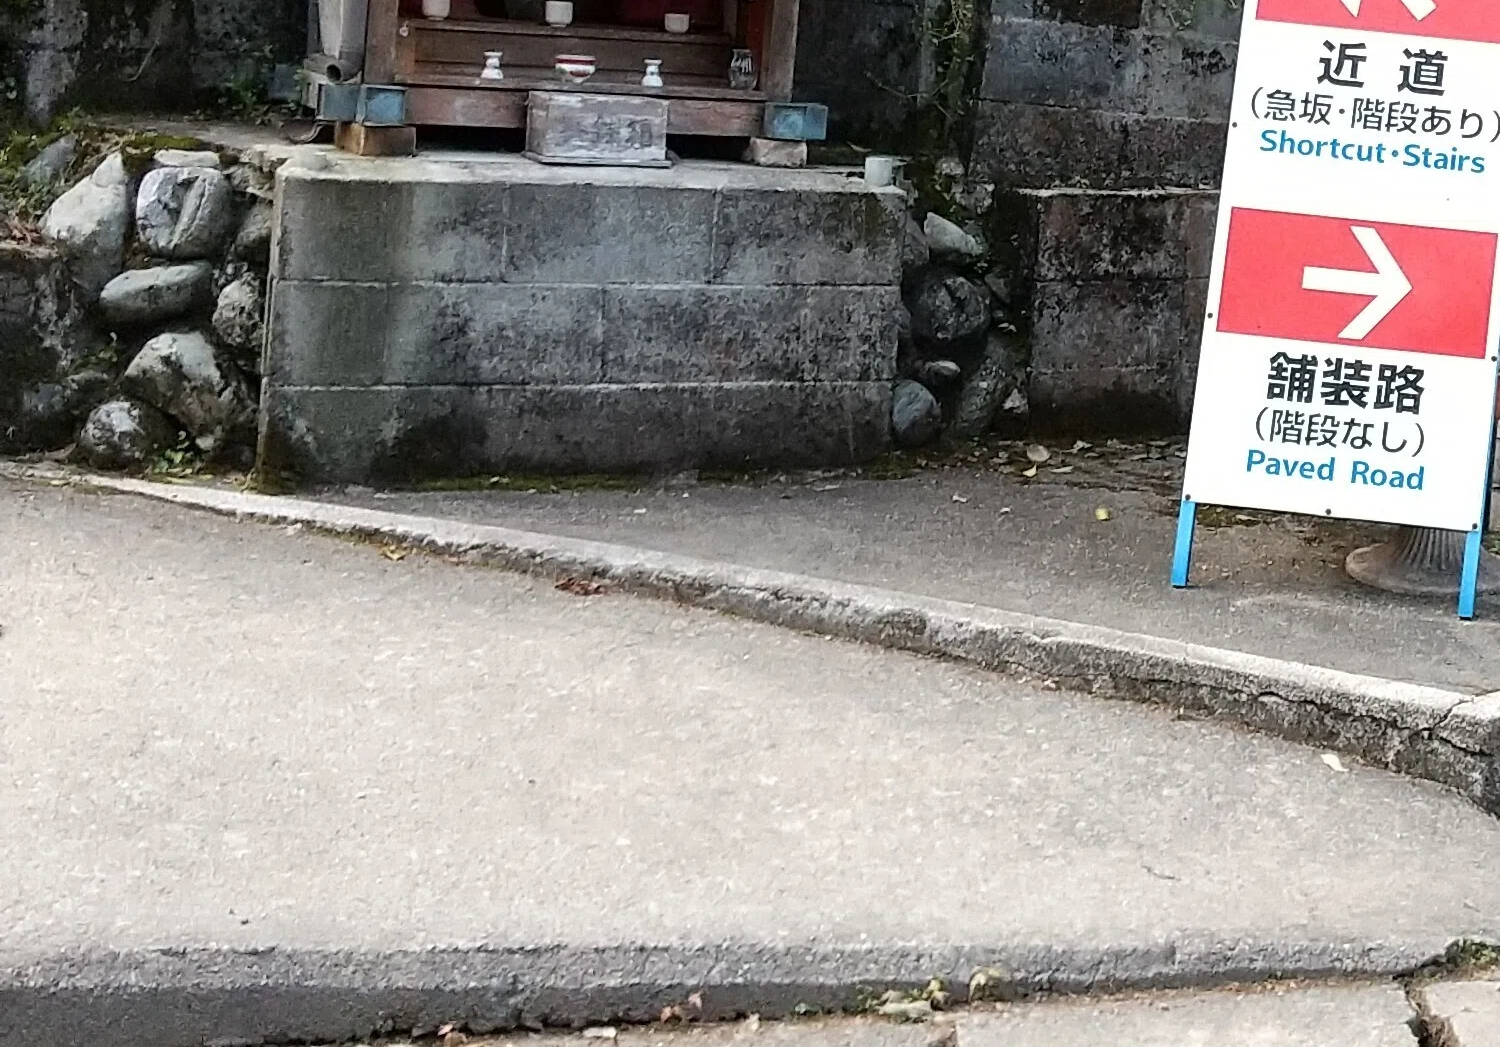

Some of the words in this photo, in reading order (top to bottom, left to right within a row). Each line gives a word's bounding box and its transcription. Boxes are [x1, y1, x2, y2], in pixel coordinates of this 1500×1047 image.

[1317, 40, 1448, 96] 近道
[1266, 351, 1425, 414] 舗装路
[1255, 406, 1425, 458] (階段なし)
[1246, 449, 1335, 482] Paved
[1350, 460, 1425, 491] Road
